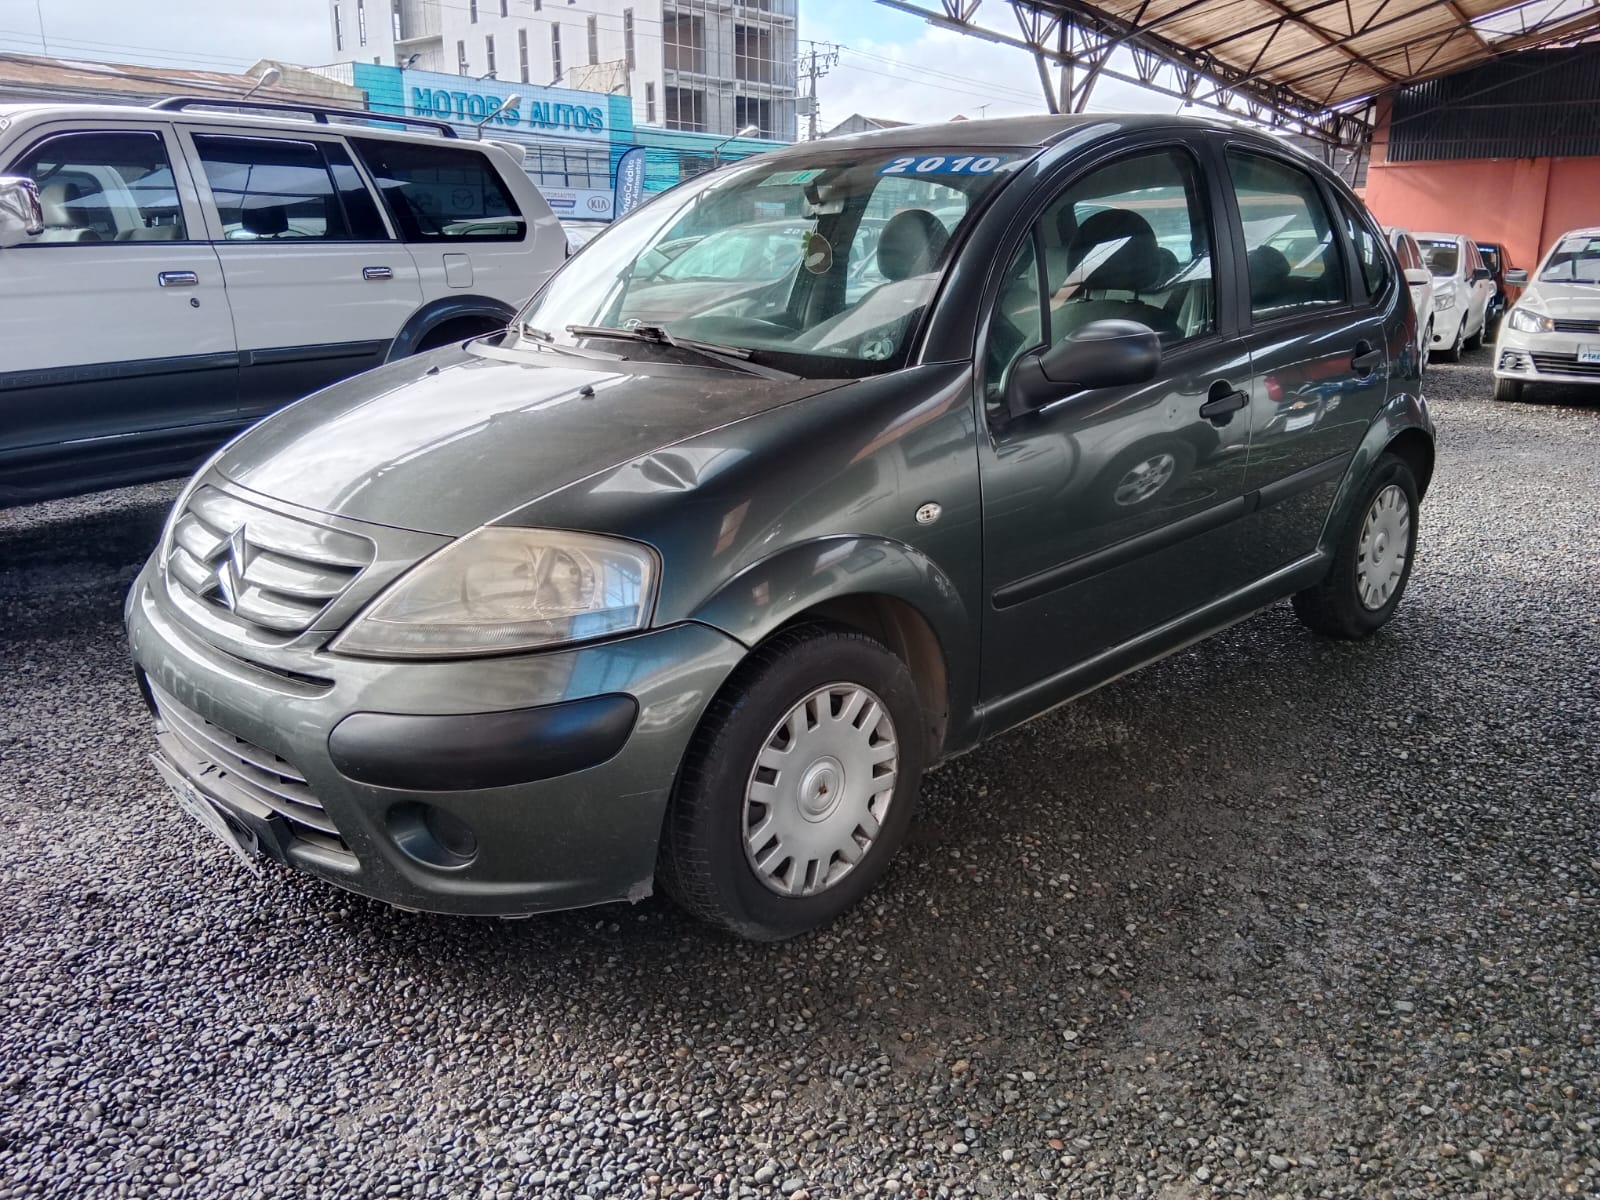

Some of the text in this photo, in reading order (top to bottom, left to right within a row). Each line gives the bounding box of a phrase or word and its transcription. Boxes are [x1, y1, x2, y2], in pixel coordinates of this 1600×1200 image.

[412, 86, 603, 134] MOTORS AUTOS
[882, 157, 1000, 173] 2010
